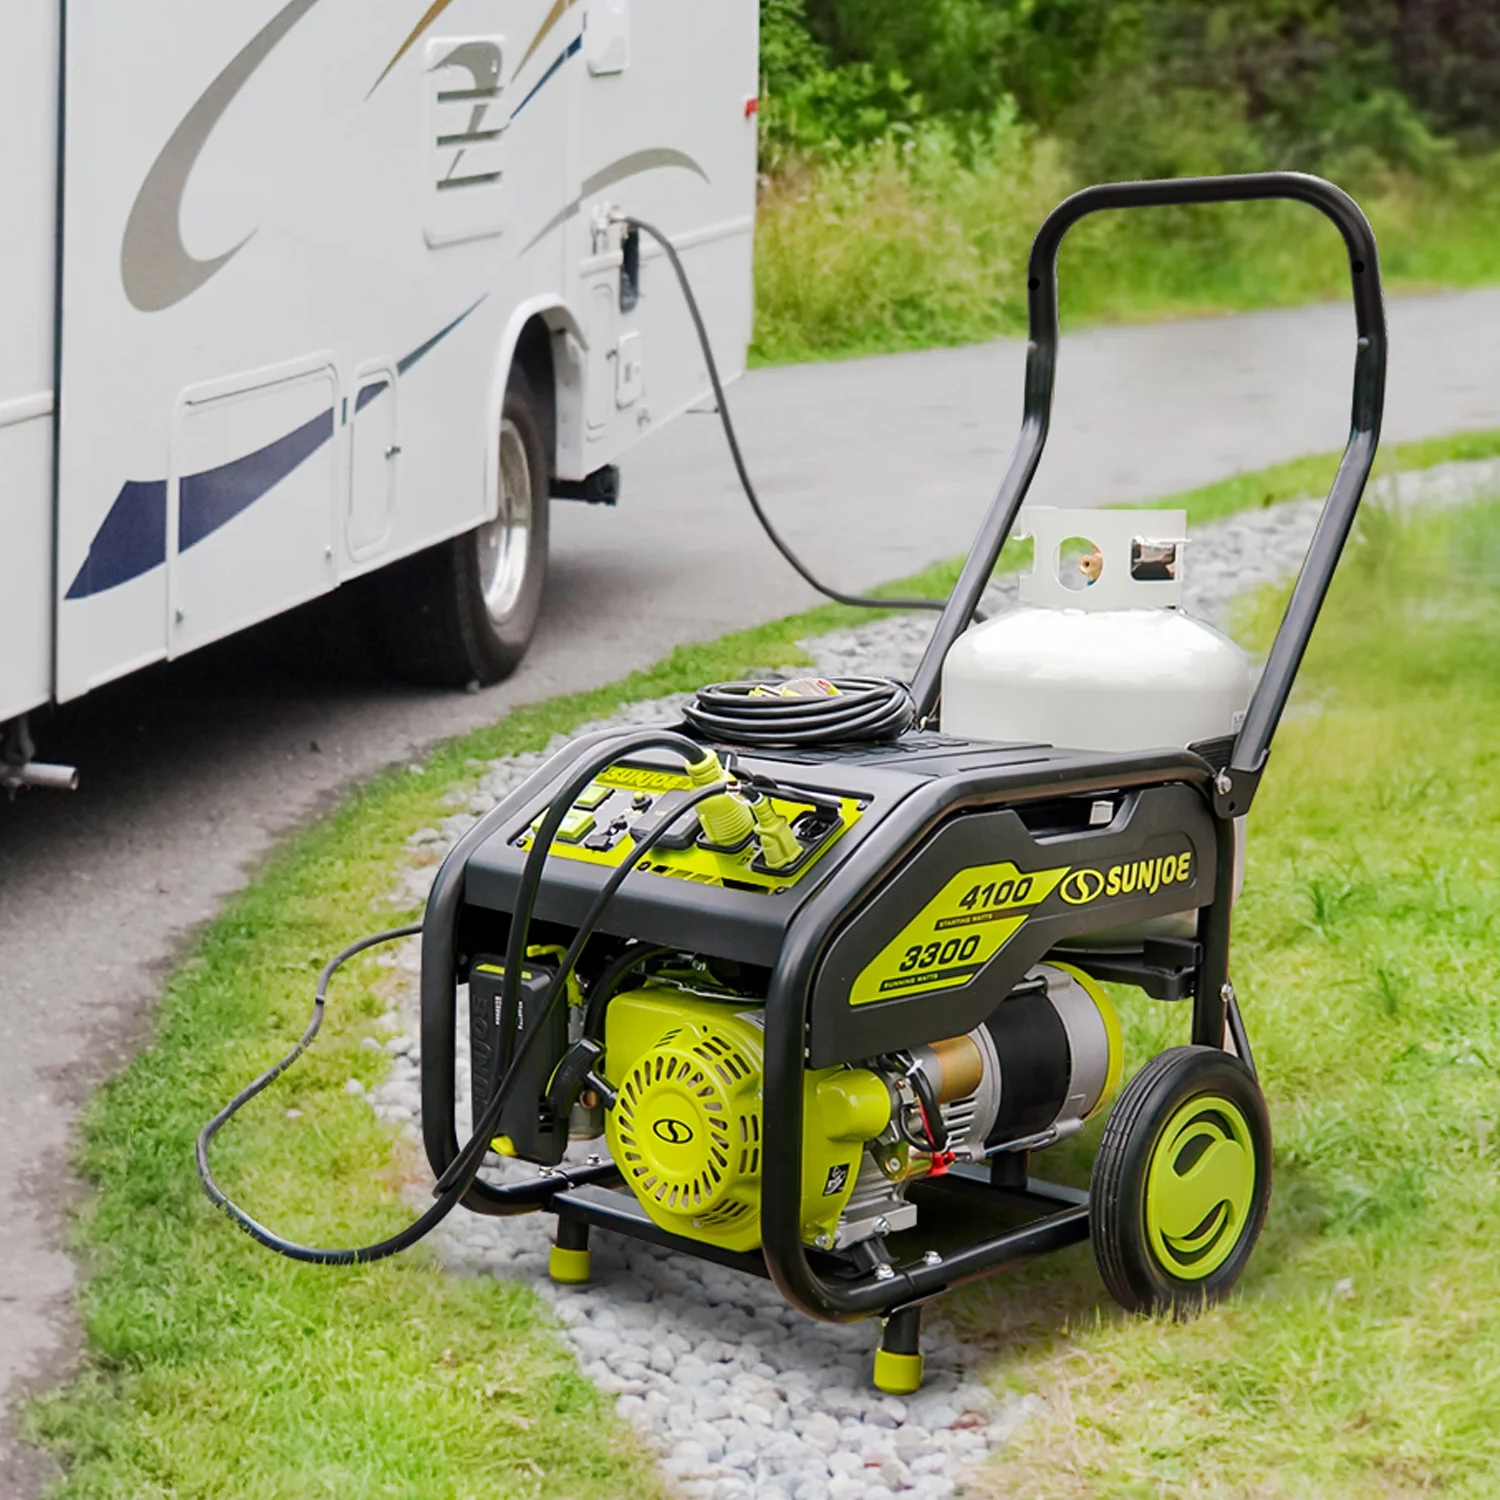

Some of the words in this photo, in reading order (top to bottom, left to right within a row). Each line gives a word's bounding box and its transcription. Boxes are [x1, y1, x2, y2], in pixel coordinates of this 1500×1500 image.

[1105, 851, 1191, 896] SUNJOE
[958, 877, 1034, 911] 4100
[939, 915, 971, 928] STARTING
[972, 913, 993, 922] WATTS
[899, 934, 981, 973] 3300
